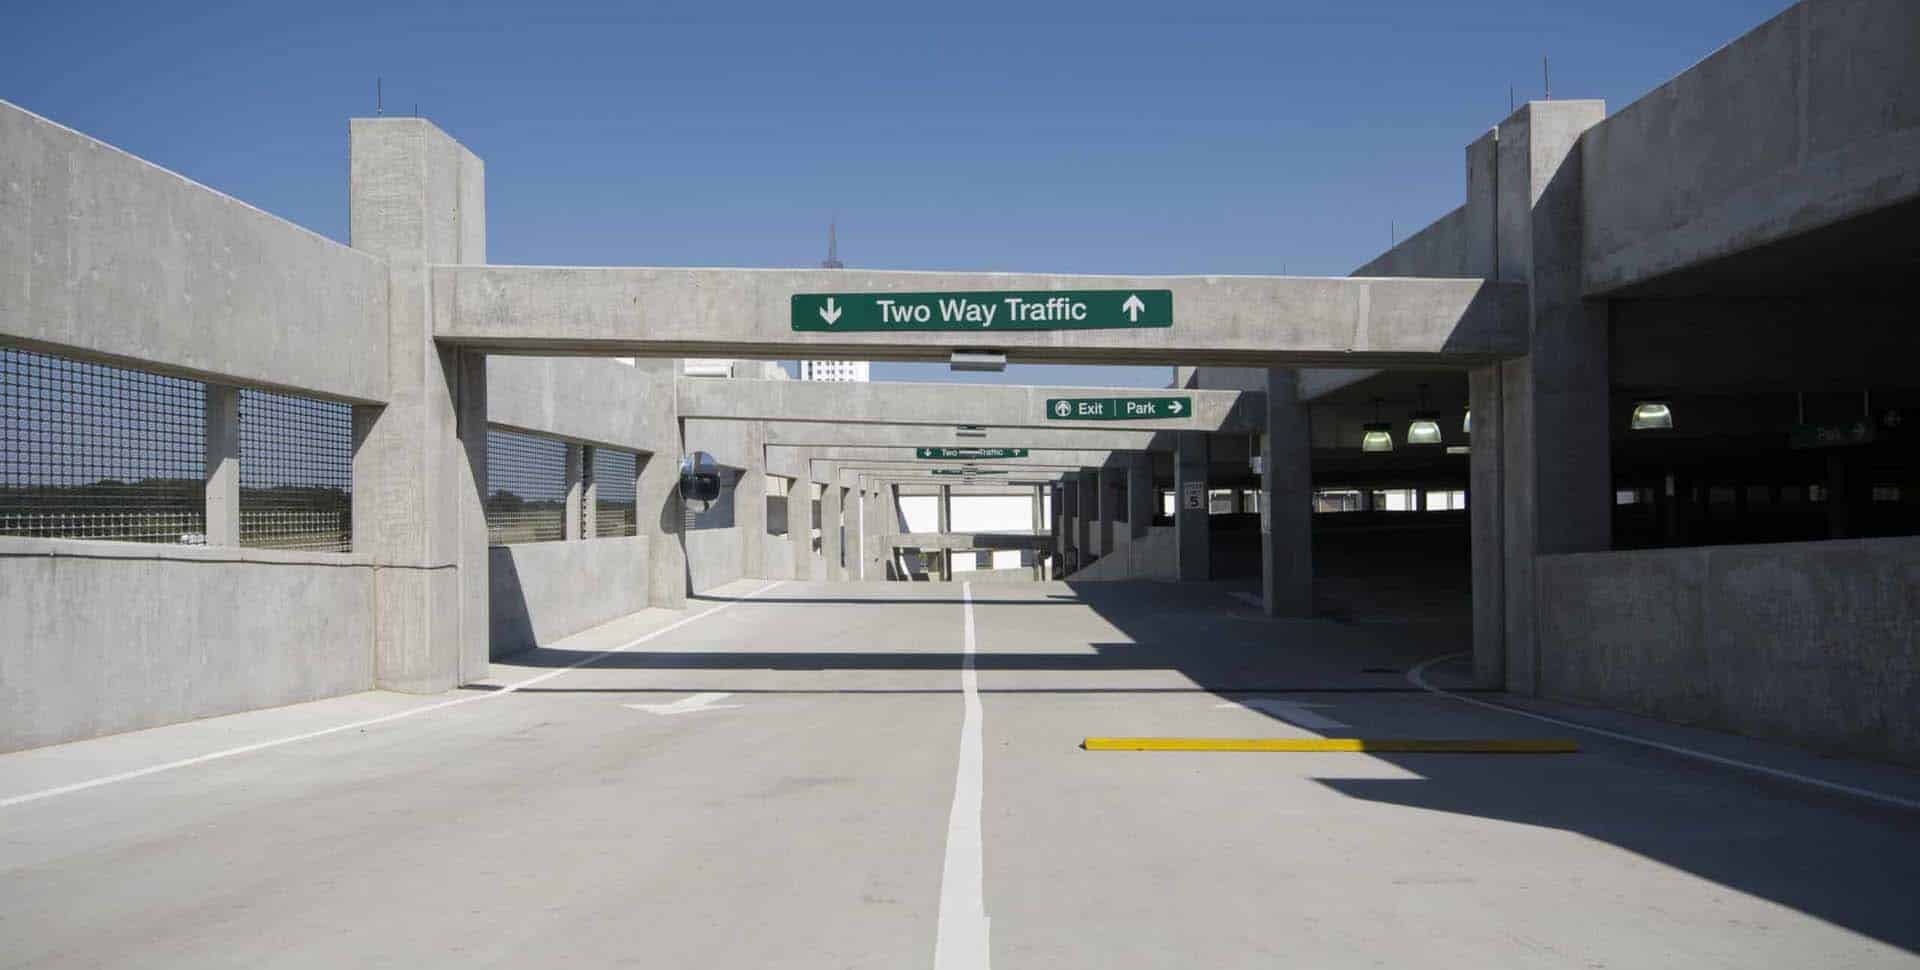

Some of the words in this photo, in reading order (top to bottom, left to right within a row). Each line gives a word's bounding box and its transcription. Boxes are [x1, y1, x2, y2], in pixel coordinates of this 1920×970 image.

[877, 300, 930, 322] Two
[939, 299, 997, 327] Way
[1005, 297, 1088, 322] Traffic
[1078, 402, 1103, 415] Exit
[1127, 401, 1155, 414] Park
[942, 448, 958, 457] Two
[1190, 495, 1200, 508] 5
